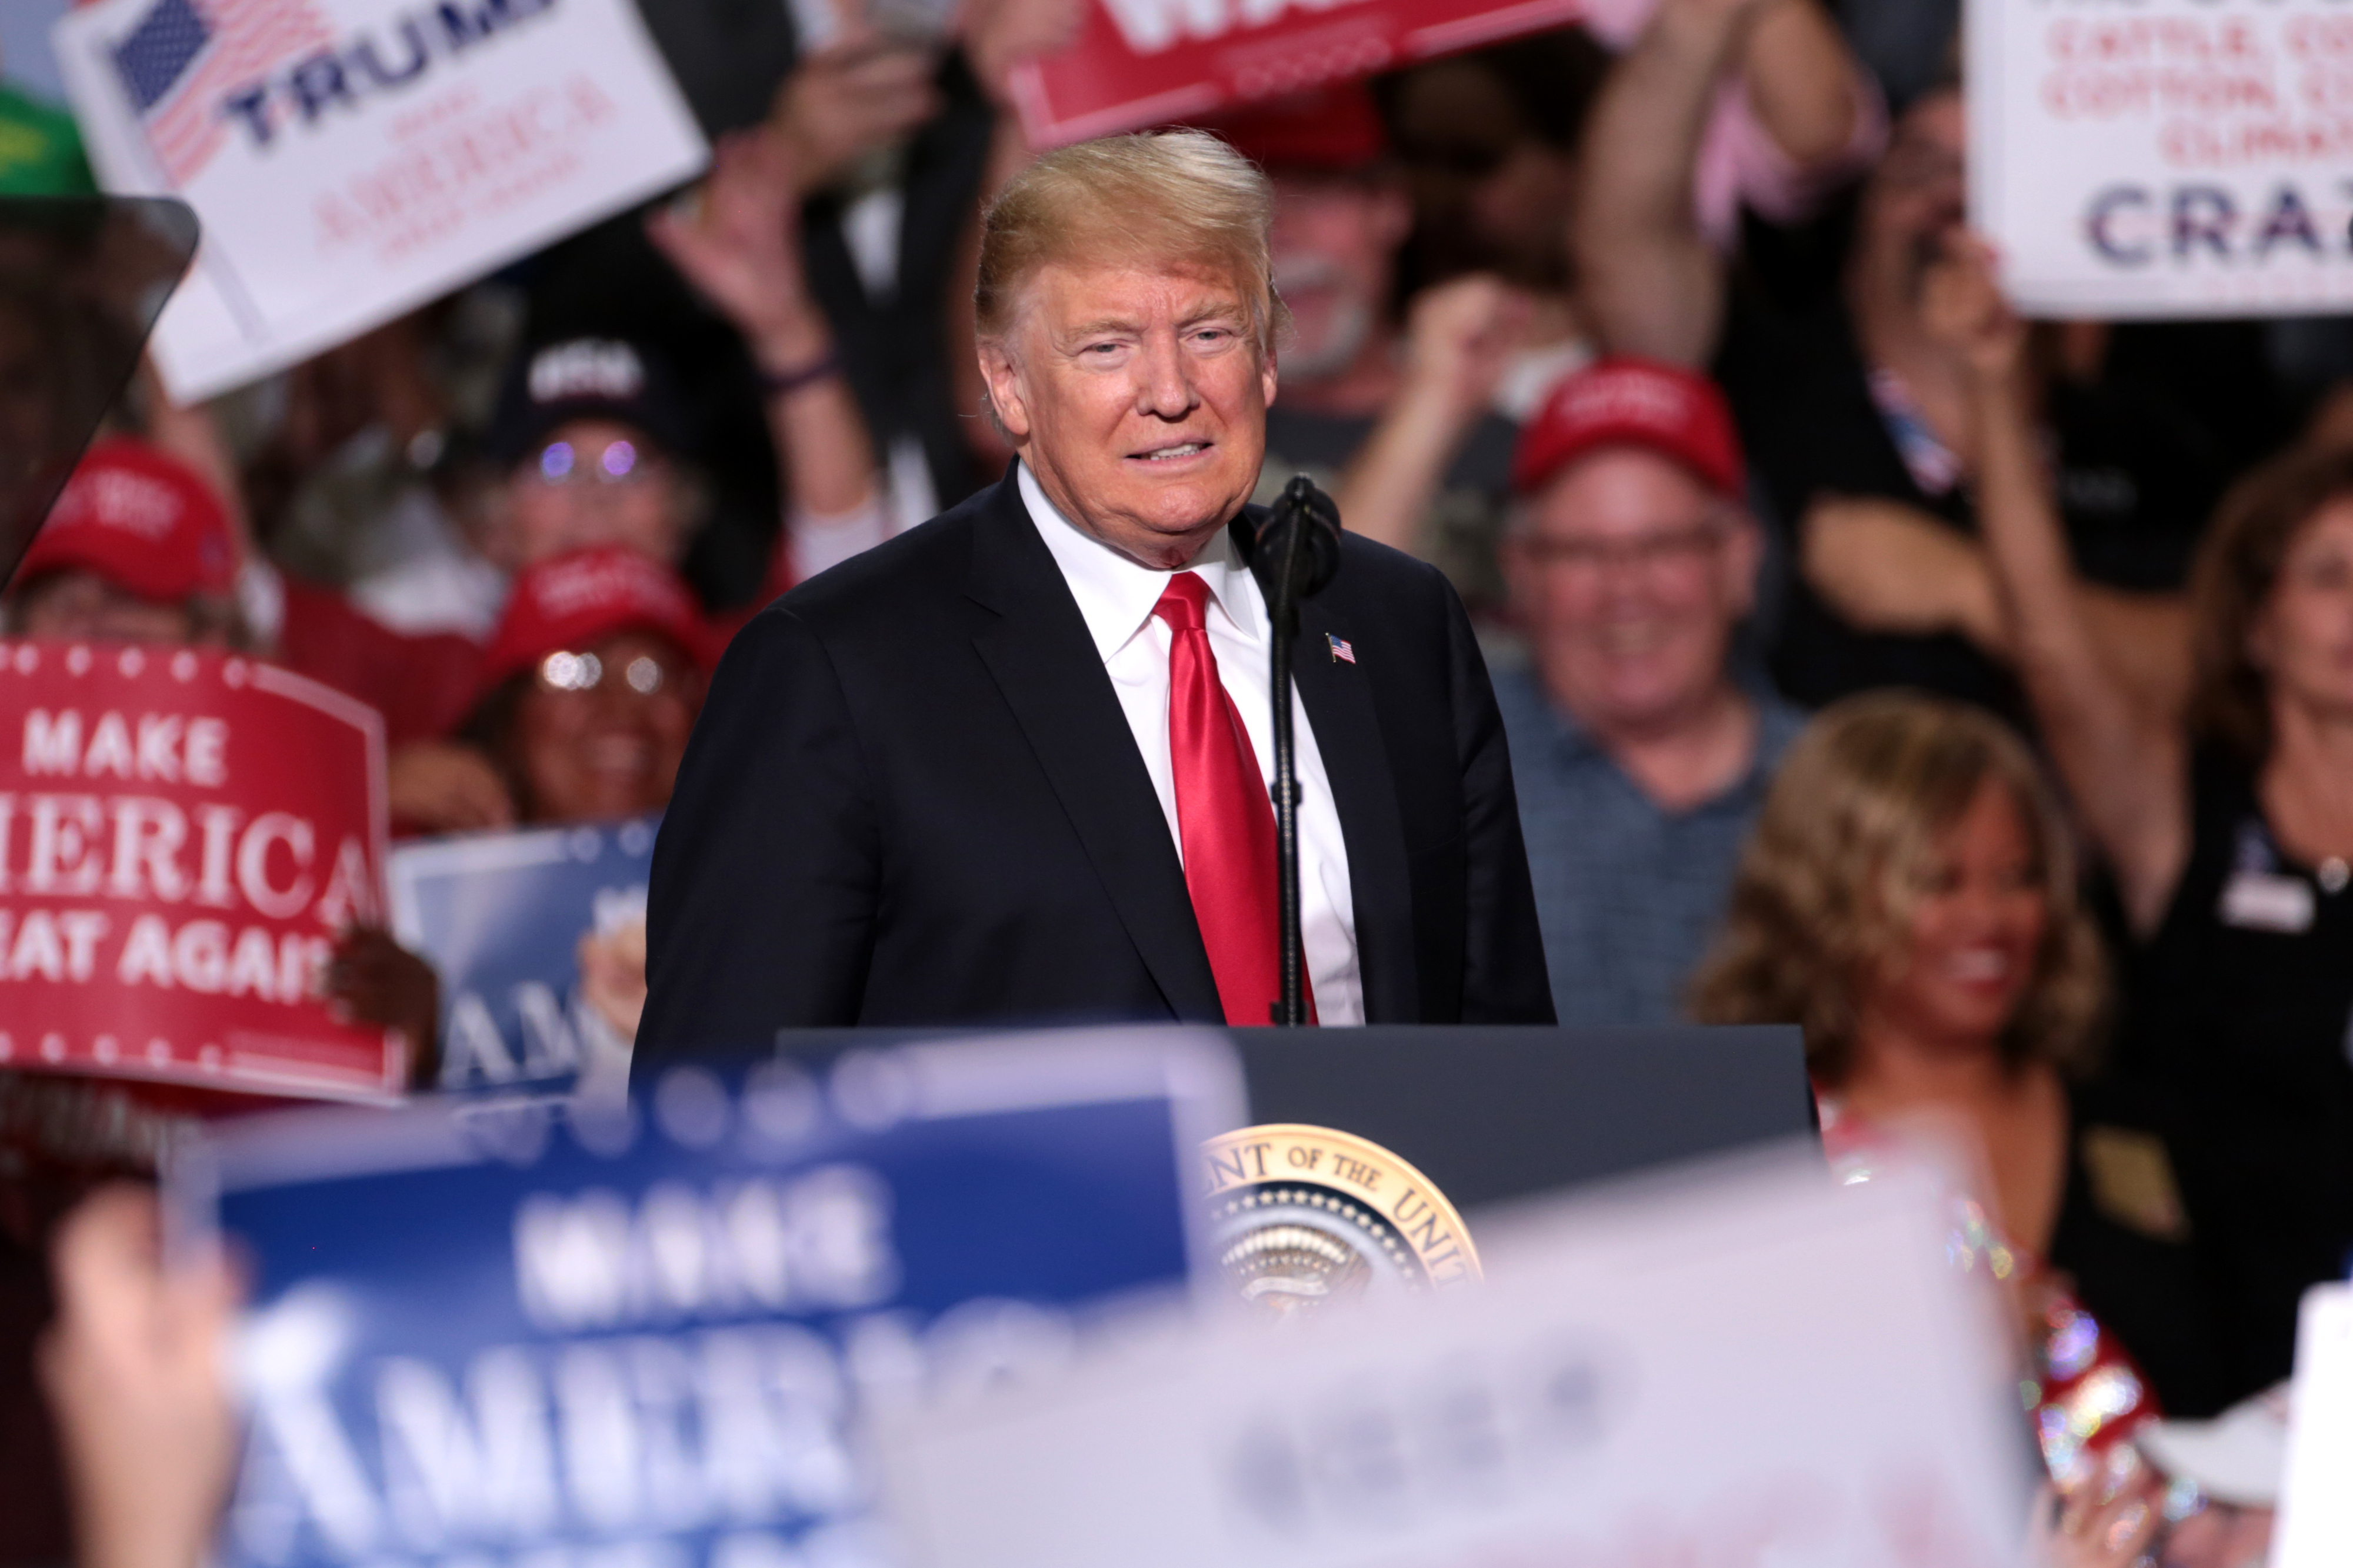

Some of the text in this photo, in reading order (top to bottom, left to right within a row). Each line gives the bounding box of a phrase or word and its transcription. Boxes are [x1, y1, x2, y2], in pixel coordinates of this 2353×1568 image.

[2082, 184, 2353, 271] CRA
[22, 708, 229, 787] MAKE
[1205, 1143, 1272, 1194] NT
[1288, 1146, 1323, 1169] OF
[1334, 1153, 1383, 1192] THE
